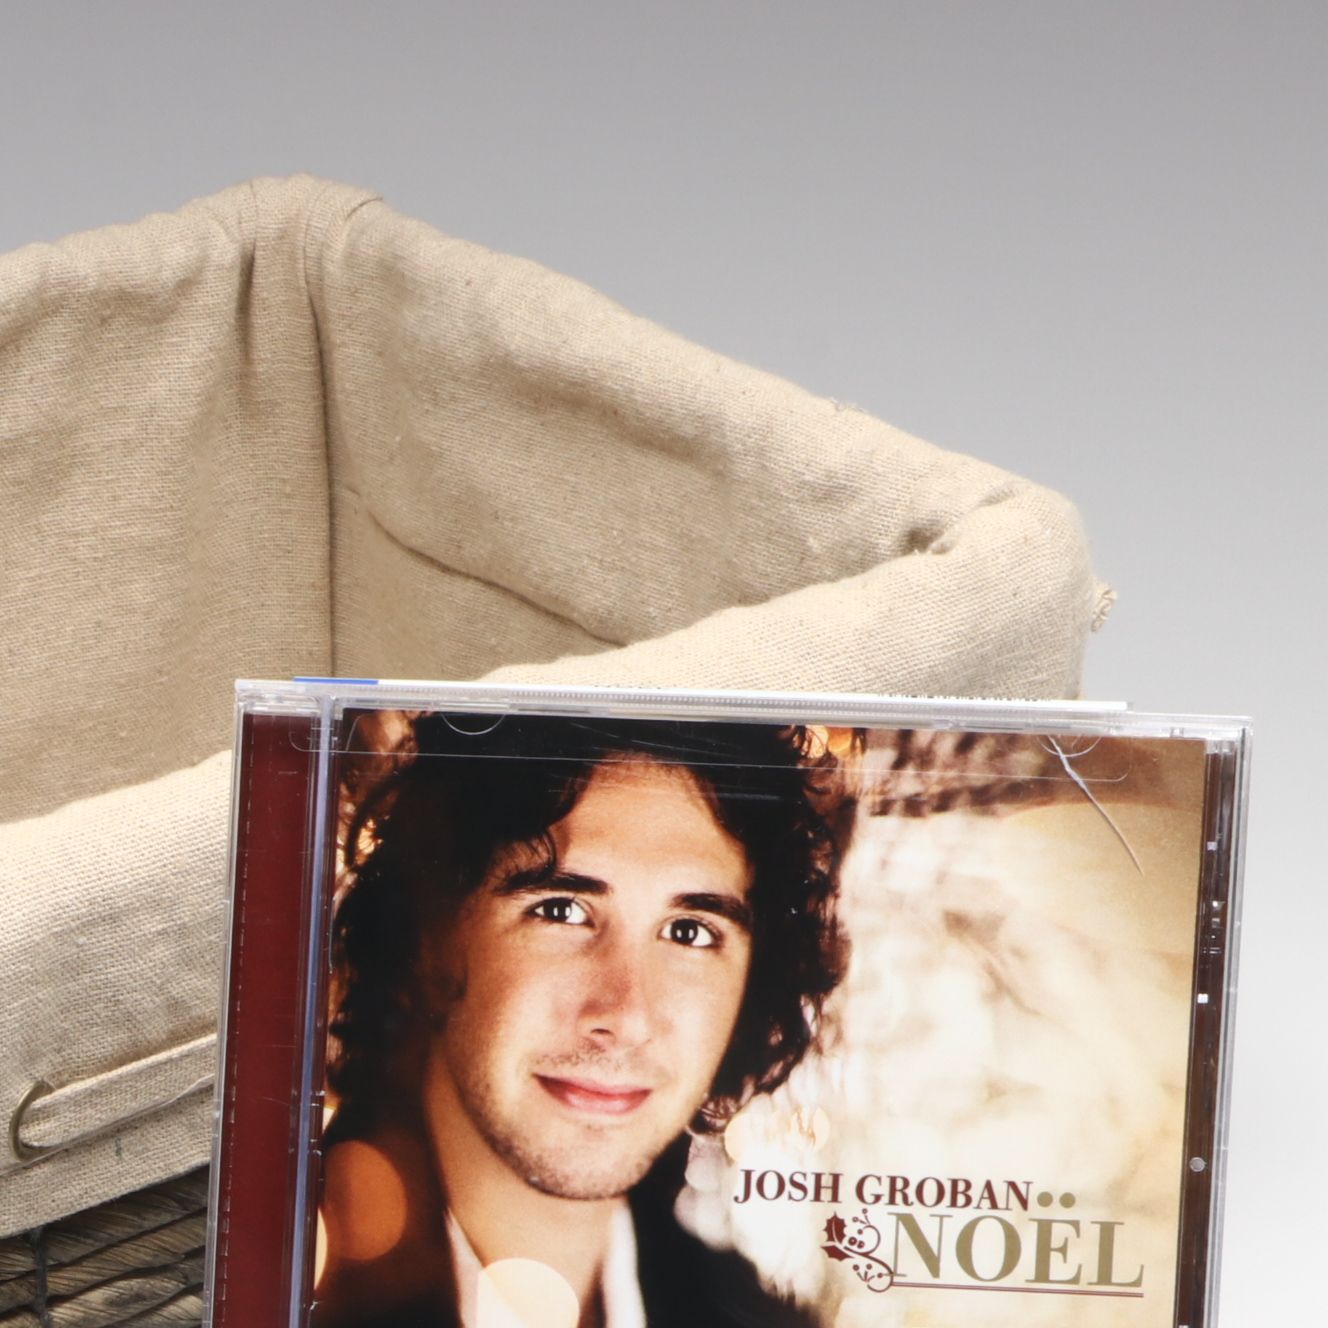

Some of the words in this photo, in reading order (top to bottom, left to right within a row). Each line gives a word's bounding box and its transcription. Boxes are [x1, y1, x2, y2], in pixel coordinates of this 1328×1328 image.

[734, 1168, 843, 1204] JOSH
[855, 1173, 1034, 1212] GROBAN
[884, 1191, 1145, 1289] NOËL
